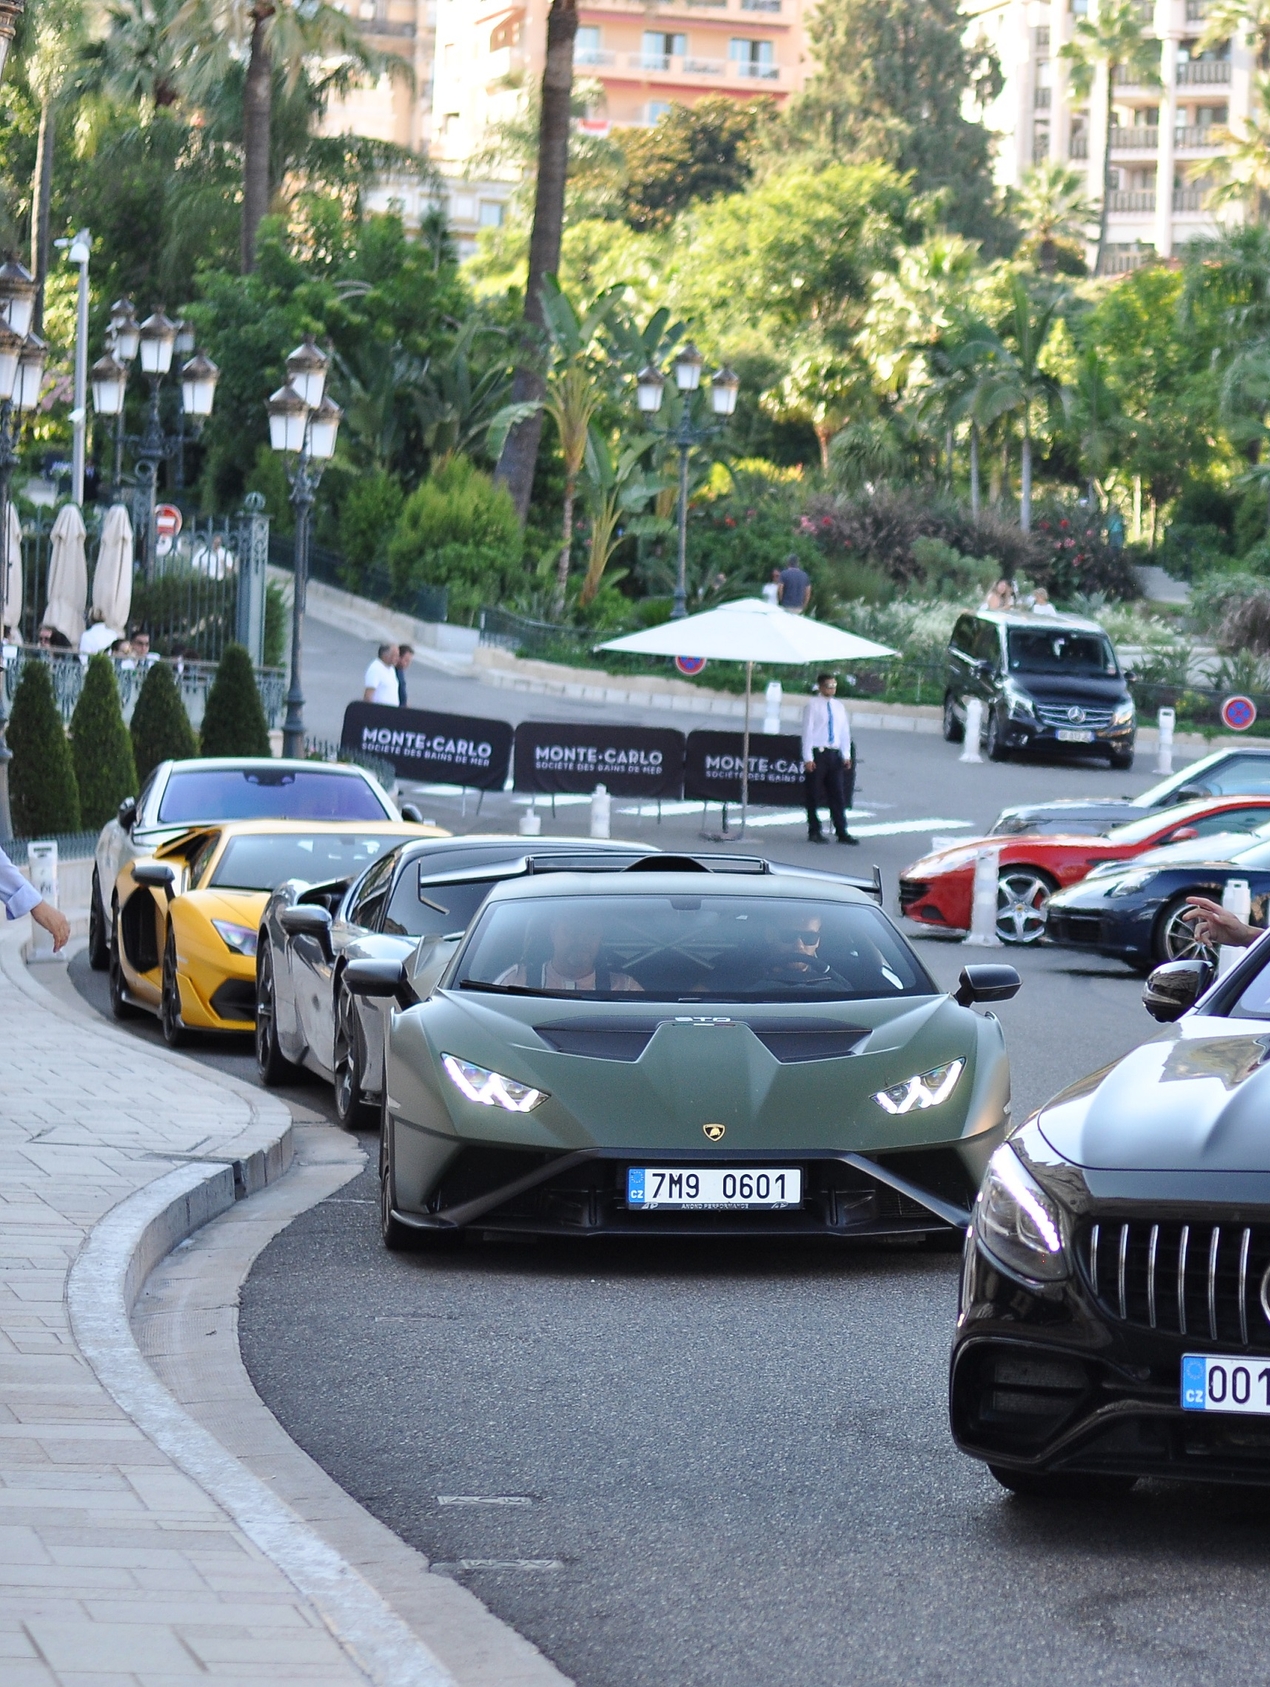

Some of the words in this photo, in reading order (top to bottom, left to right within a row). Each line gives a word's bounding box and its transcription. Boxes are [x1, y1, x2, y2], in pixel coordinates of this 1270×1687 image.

[403, 748, 422, 759] DES
[424, 750, 452, 762] BAINS
[455, 754, 467, 764] DE
[470, 756, 490, 767] MER
[577, 763, 595, 772] DES
[651, 1172, 700, 1199] 7M9
[722, 1173, 786, 1200] 0601
[630, 1189, 644, 1199] CZ
[1185, 1390, 1204, 1402] CZ
